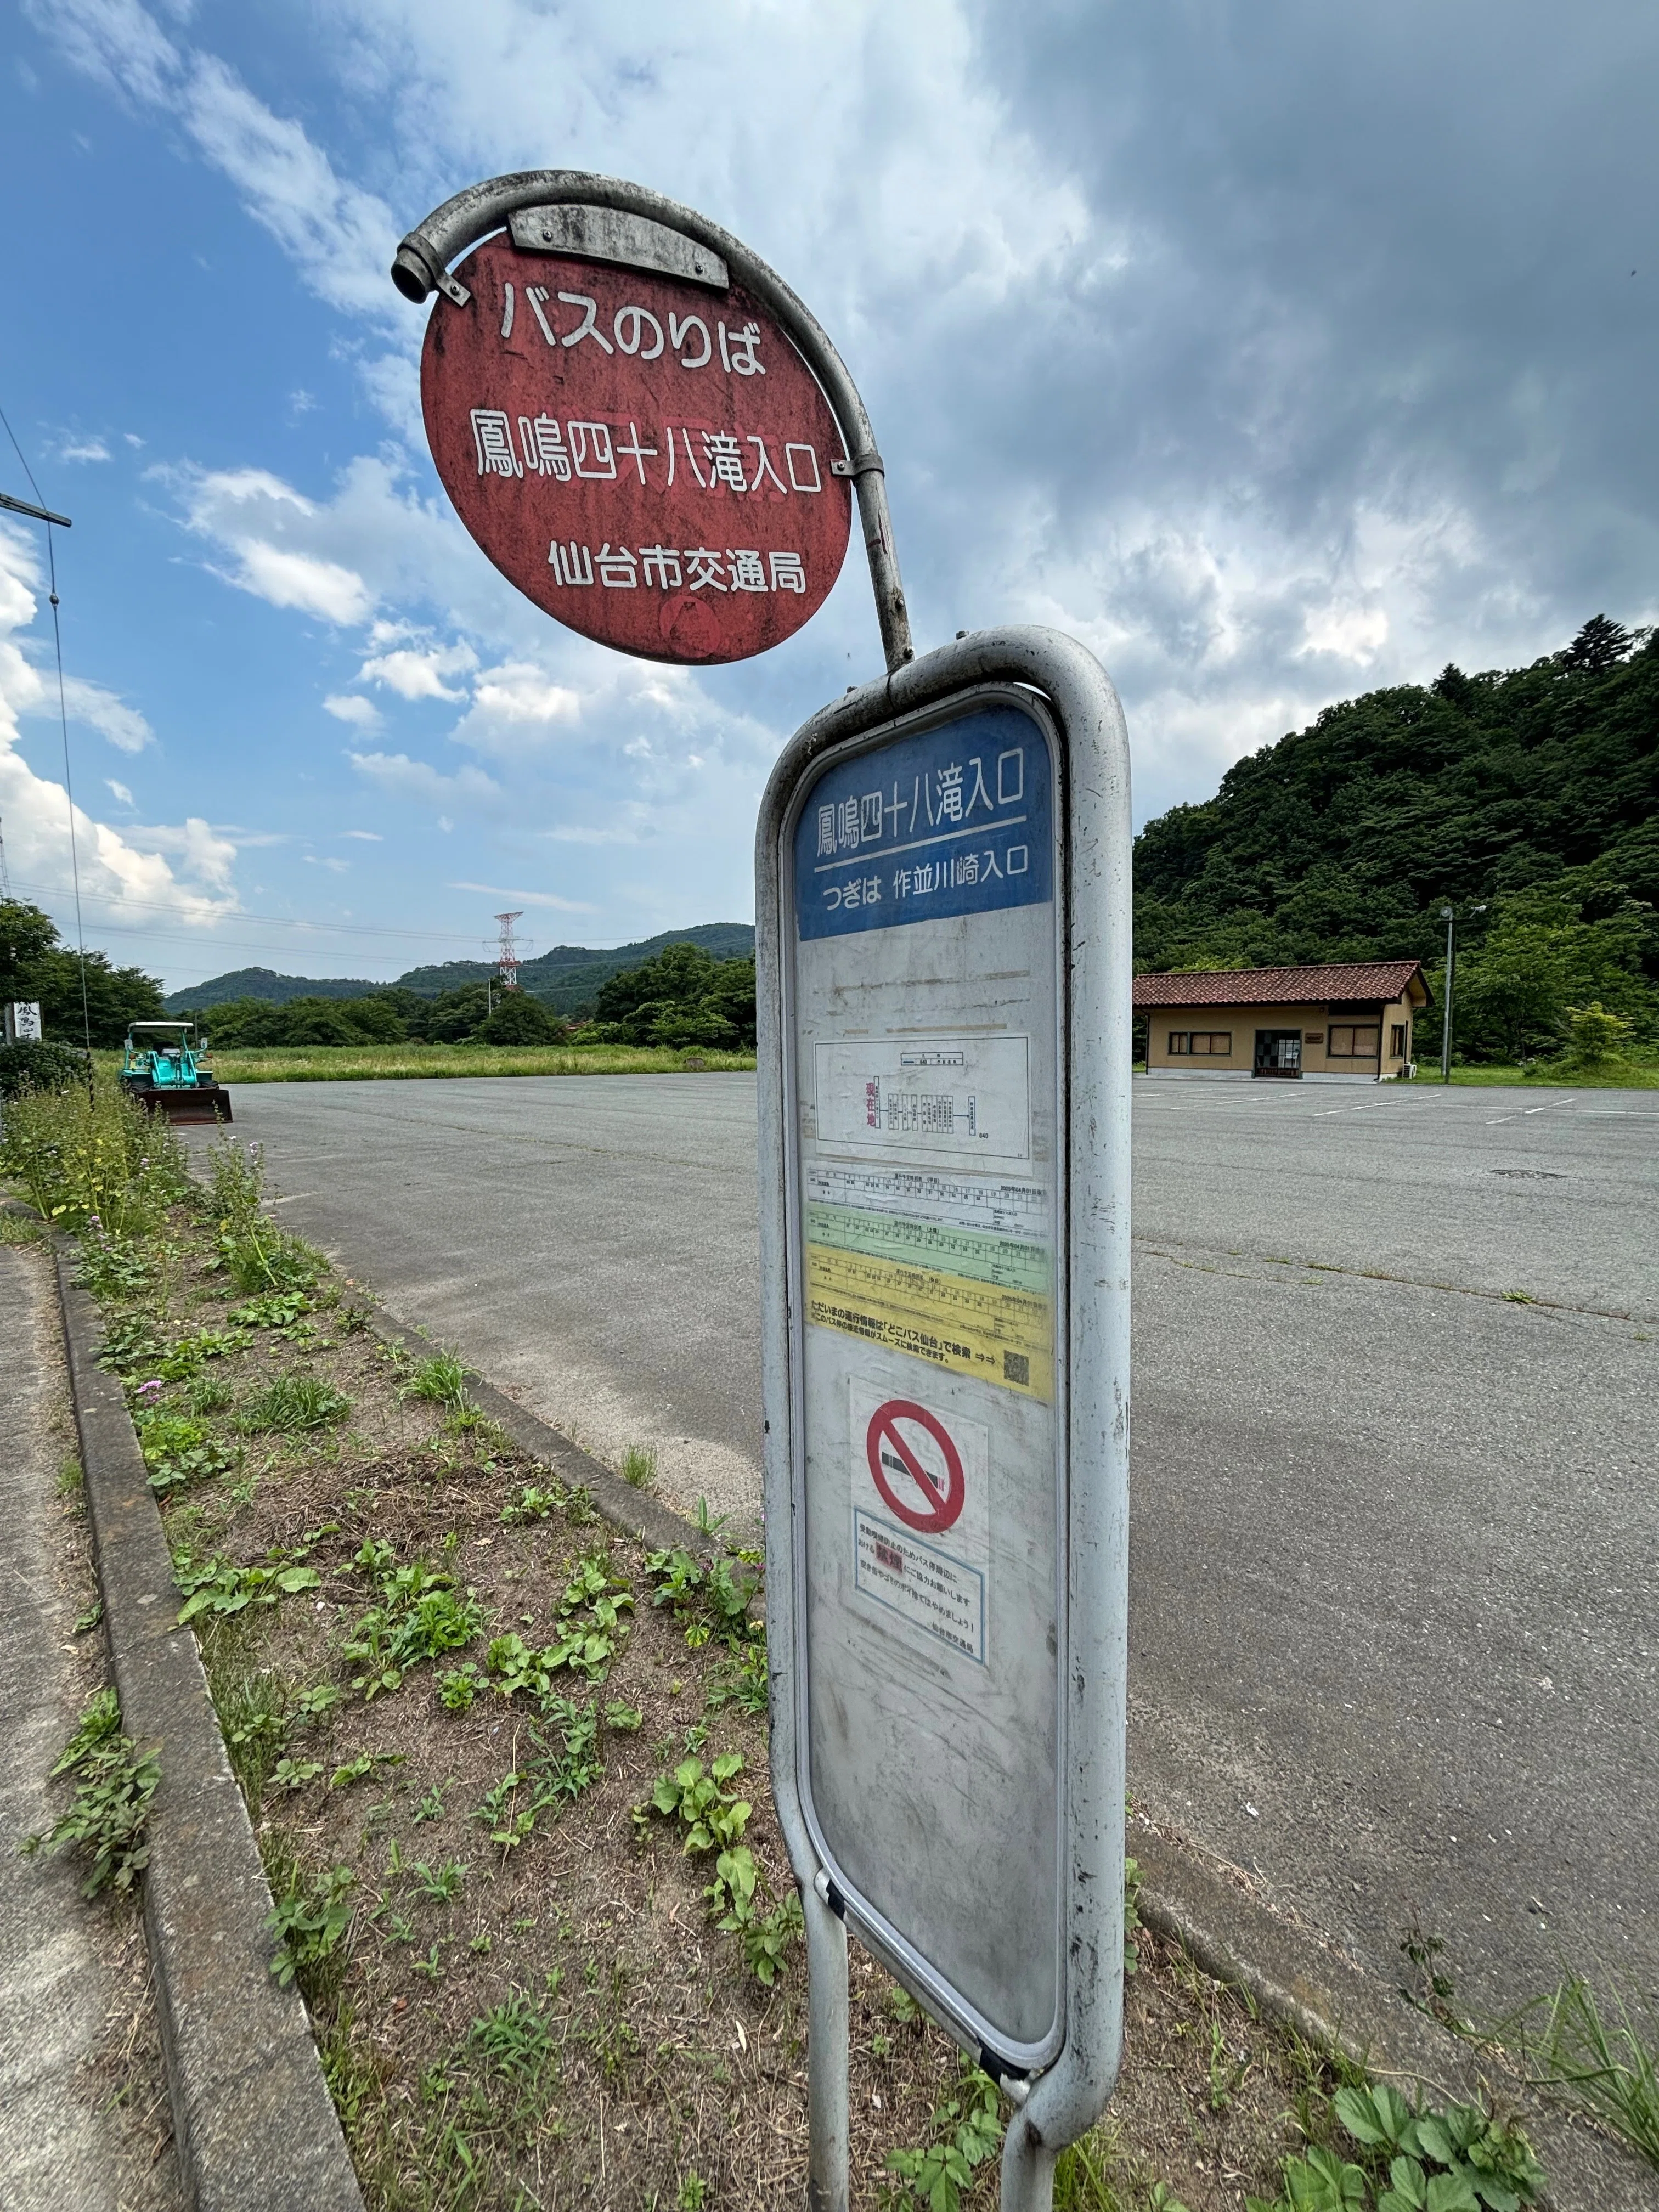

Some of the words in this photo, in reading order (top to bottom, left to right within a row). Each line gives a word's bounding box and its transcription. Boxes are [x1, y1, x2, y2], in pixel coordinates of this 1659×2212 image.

[500, 283, 766, 376] バスのりば
[470, 408, 822, 495] 鳳鳴四十八滝入口
[548, 540, 807, 594] 仙台市交通局
[817, 747, 1024, 857] 鳳鳴四十八滝入口
[823, 875, 882, 911] つぎは
[893, 845, 1028, 900] 作並川崎入口
[866, 1082, 876, 1127] 現在地
[932, 1622, 974, 1654] 仙台市交通局
